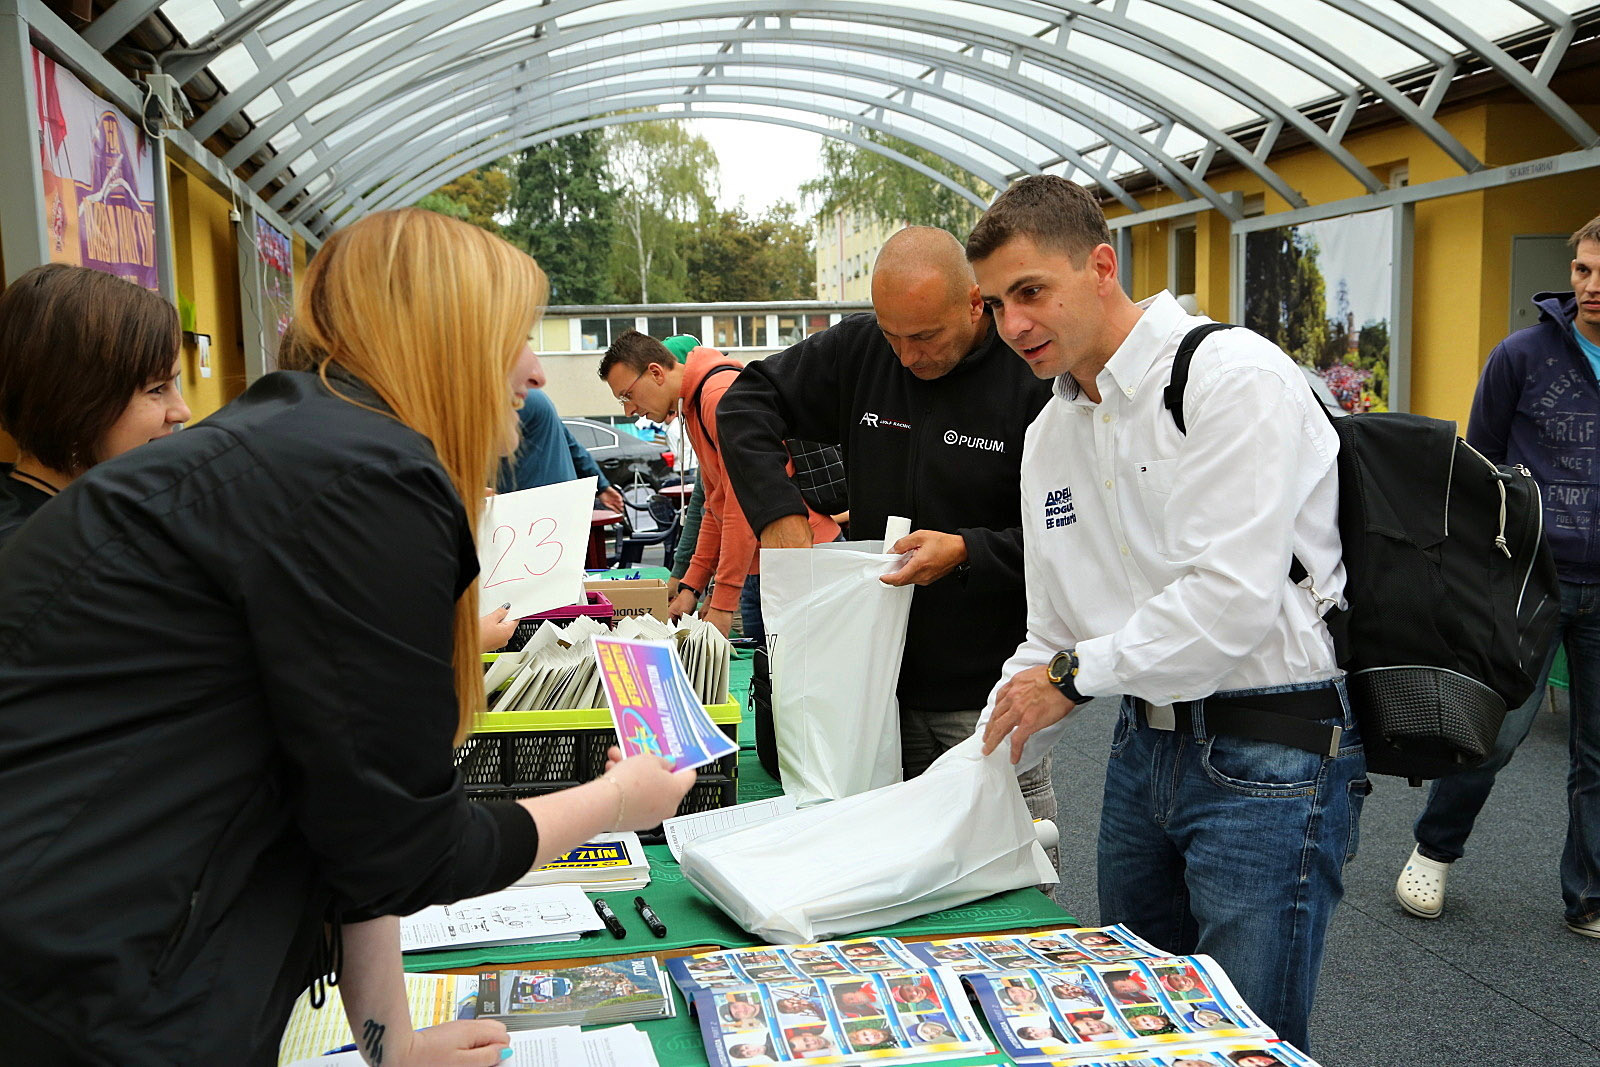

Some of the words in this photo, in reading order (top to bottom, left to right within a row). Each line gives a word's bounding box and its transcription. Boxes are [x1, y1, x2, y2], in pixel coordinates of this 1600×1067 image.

[957, 433, 1005, 453] PURUM
[1547, 485, 1590, 505] FAIRY
[483, 517, 564, 589] 23
[631, 960, 648, 976] RALLY
